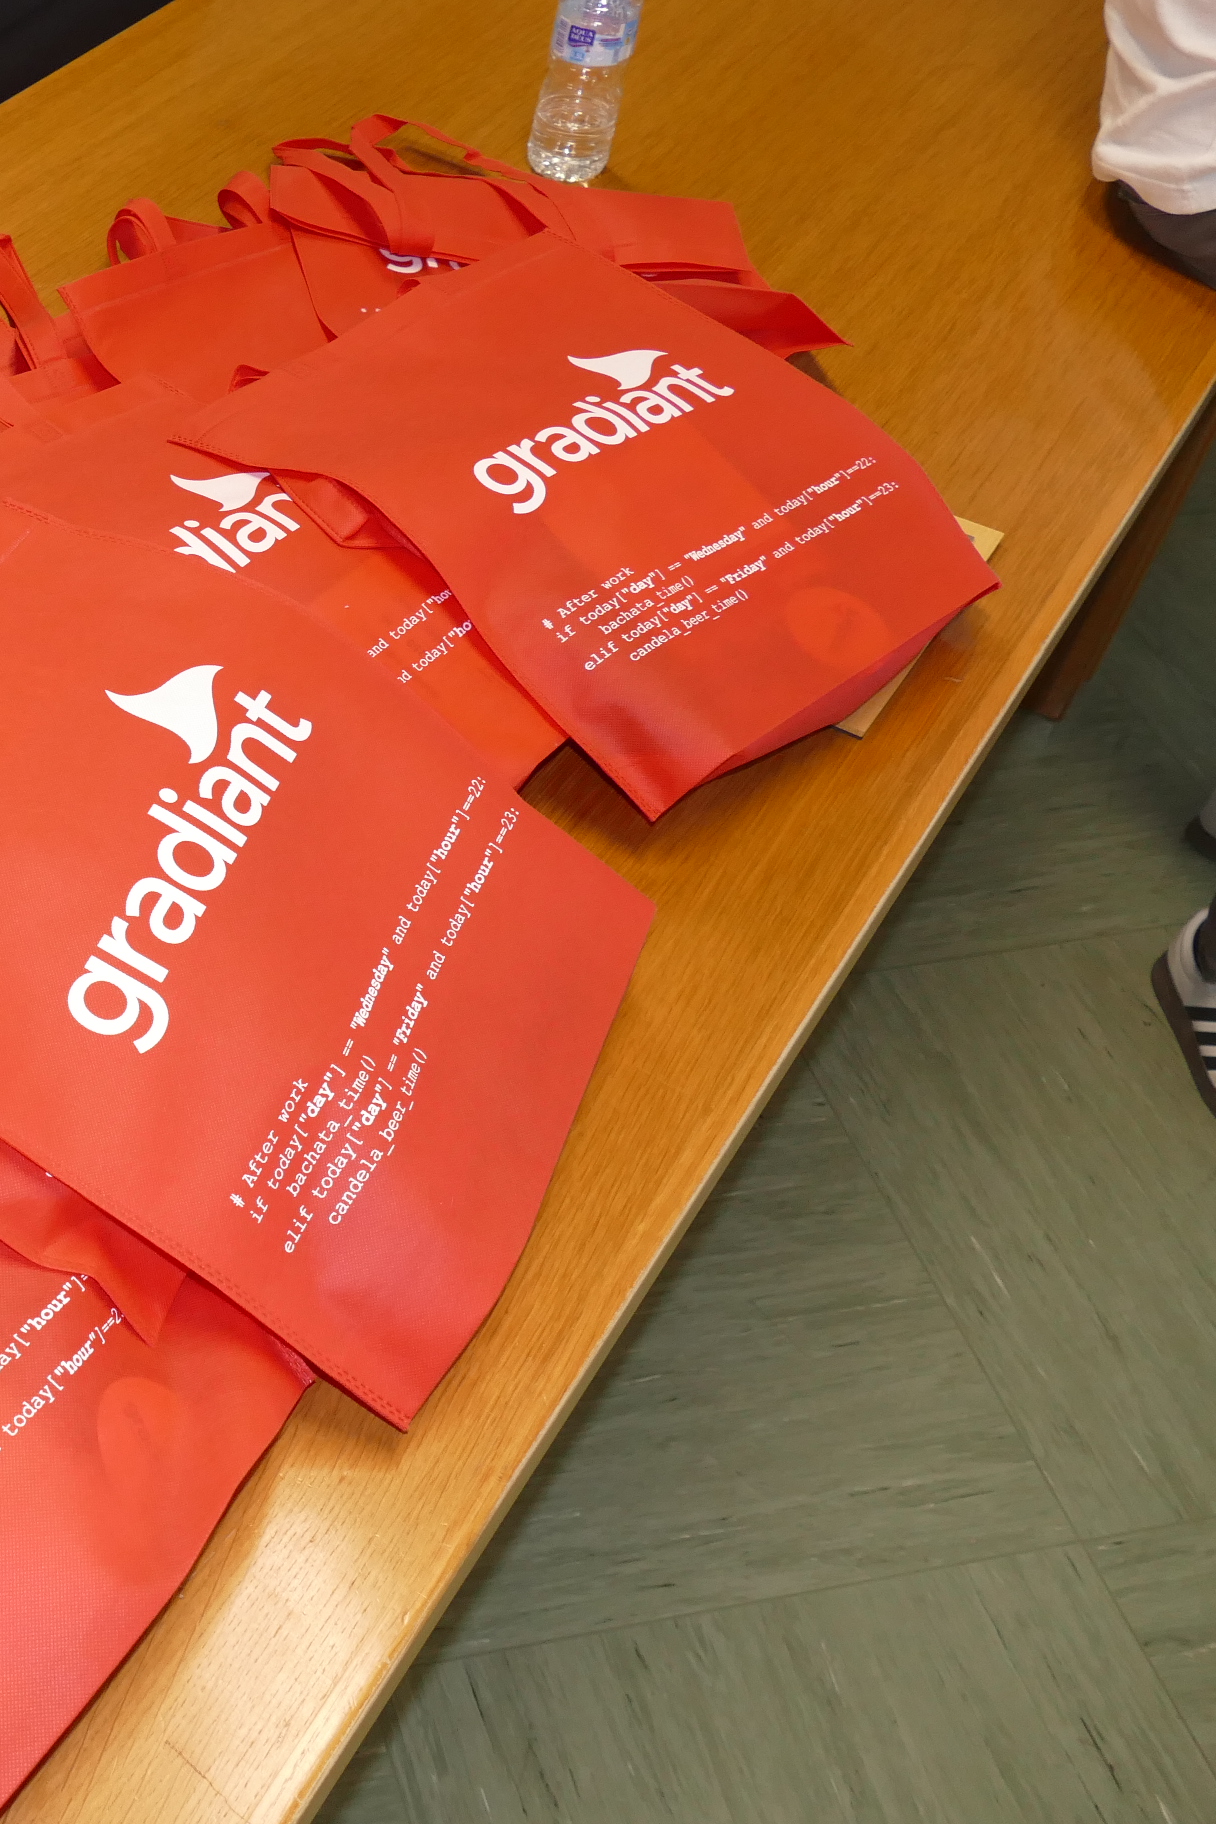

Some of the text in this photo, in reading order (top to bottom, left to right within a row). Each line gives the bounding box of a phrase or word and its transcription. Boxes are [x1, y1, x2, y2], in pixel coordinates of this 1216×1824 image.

[473, 364, 735, 514] gradiant
[169, 485, 301, 574] dian
[555, 624, 577, 644] if
[667, 561, 682, 572] ==
[751, 512, 775, 530] and
[541, 567, 635, 630] # After work
[584, 640, 620, 671] elif
[704, 584, 719, 594] ==
[719, 554, 767, 585] "Friday"
[772, 541, 796, 559] and
[67, 689, 313, 1054] gradiant
[249, 1195, 269, 1224] if
[342, 1038, 354, 1057] ==
[391, 915, 412, 945] and
[284, 1204, 314, 1254] elif
[386, 1053, 398, 1072] ==
[392, 982, 429, 1046] "Friday"
[426, 949, 446, 980] and
[229, 1078, 309, 1208] # After work
[1, 1307, 125, 1437] today["hour"]==2
